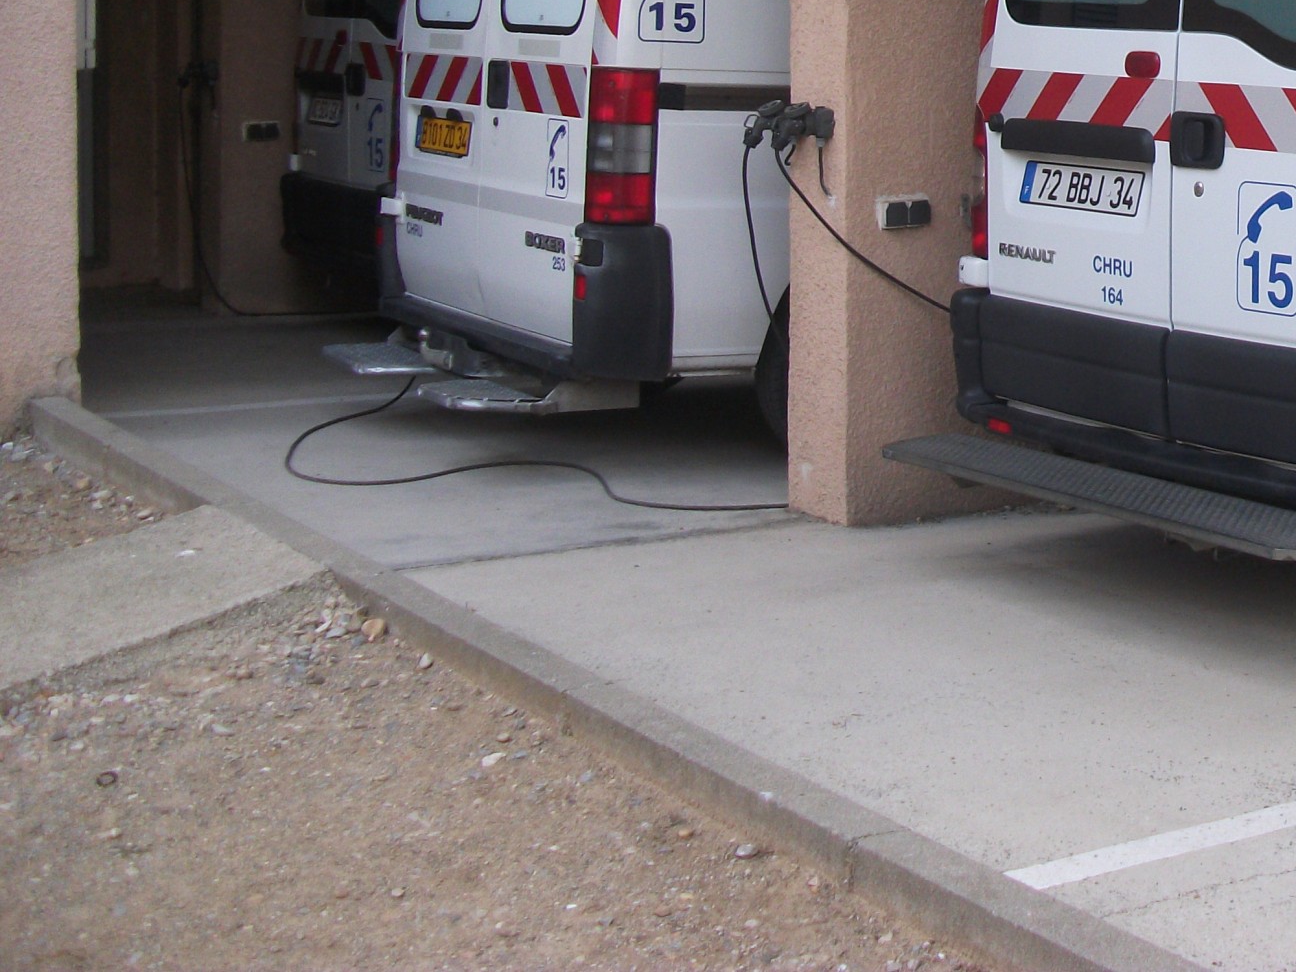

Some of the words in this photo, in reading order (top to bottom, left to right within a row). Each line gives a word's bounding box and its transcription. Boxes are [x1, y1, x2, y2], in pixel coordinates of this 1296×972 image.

[648, 2, 696, 33] 15
[367, 137, 384, 168] 15
[550, 166, 566, 191] 15
[1038, 168, 1063, 201] 72
[1066, 171, 1106, 207] BBJ
[1109, 176, 1136, 210] 34
[525, 231, 566, 254] BOXER
[999, 242, 1057, 264] RENAULT
[552, 256, 566, 272] 253
[1093, 255, 1133, 278] CHRU
[1242, 250, 1295, 309] 15
[1101, 285, 1124, 306] 164
